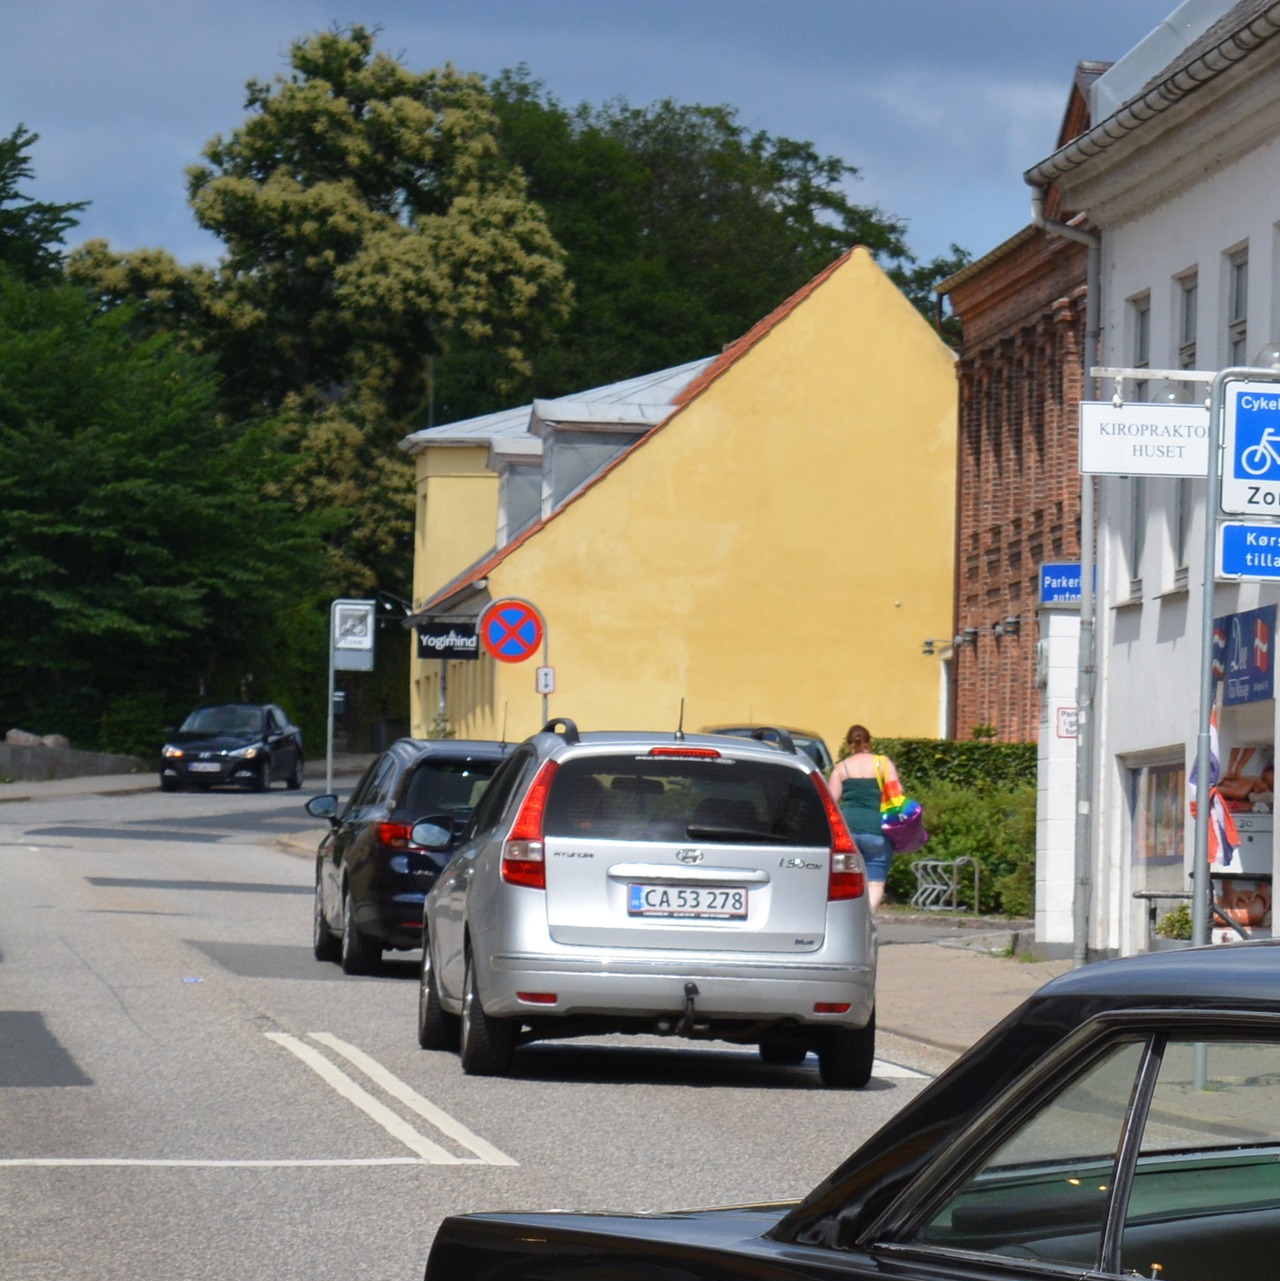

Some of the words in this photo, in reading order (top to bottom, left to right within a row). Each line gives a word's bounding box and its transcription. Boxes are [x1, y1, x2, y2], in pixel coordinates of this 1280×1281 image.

[1099, 423, 1210, 438] KIROPRAKTO
[1132, 445, 1186, 458] HUSET
[1044, 576, 1082, 588] Parkeri
[420, 633, 477, 650] Yogimind
[645, 889, 671, 908] CA
[677, 891, 700, 909] 53
[706, 892, 743, 910] 278
